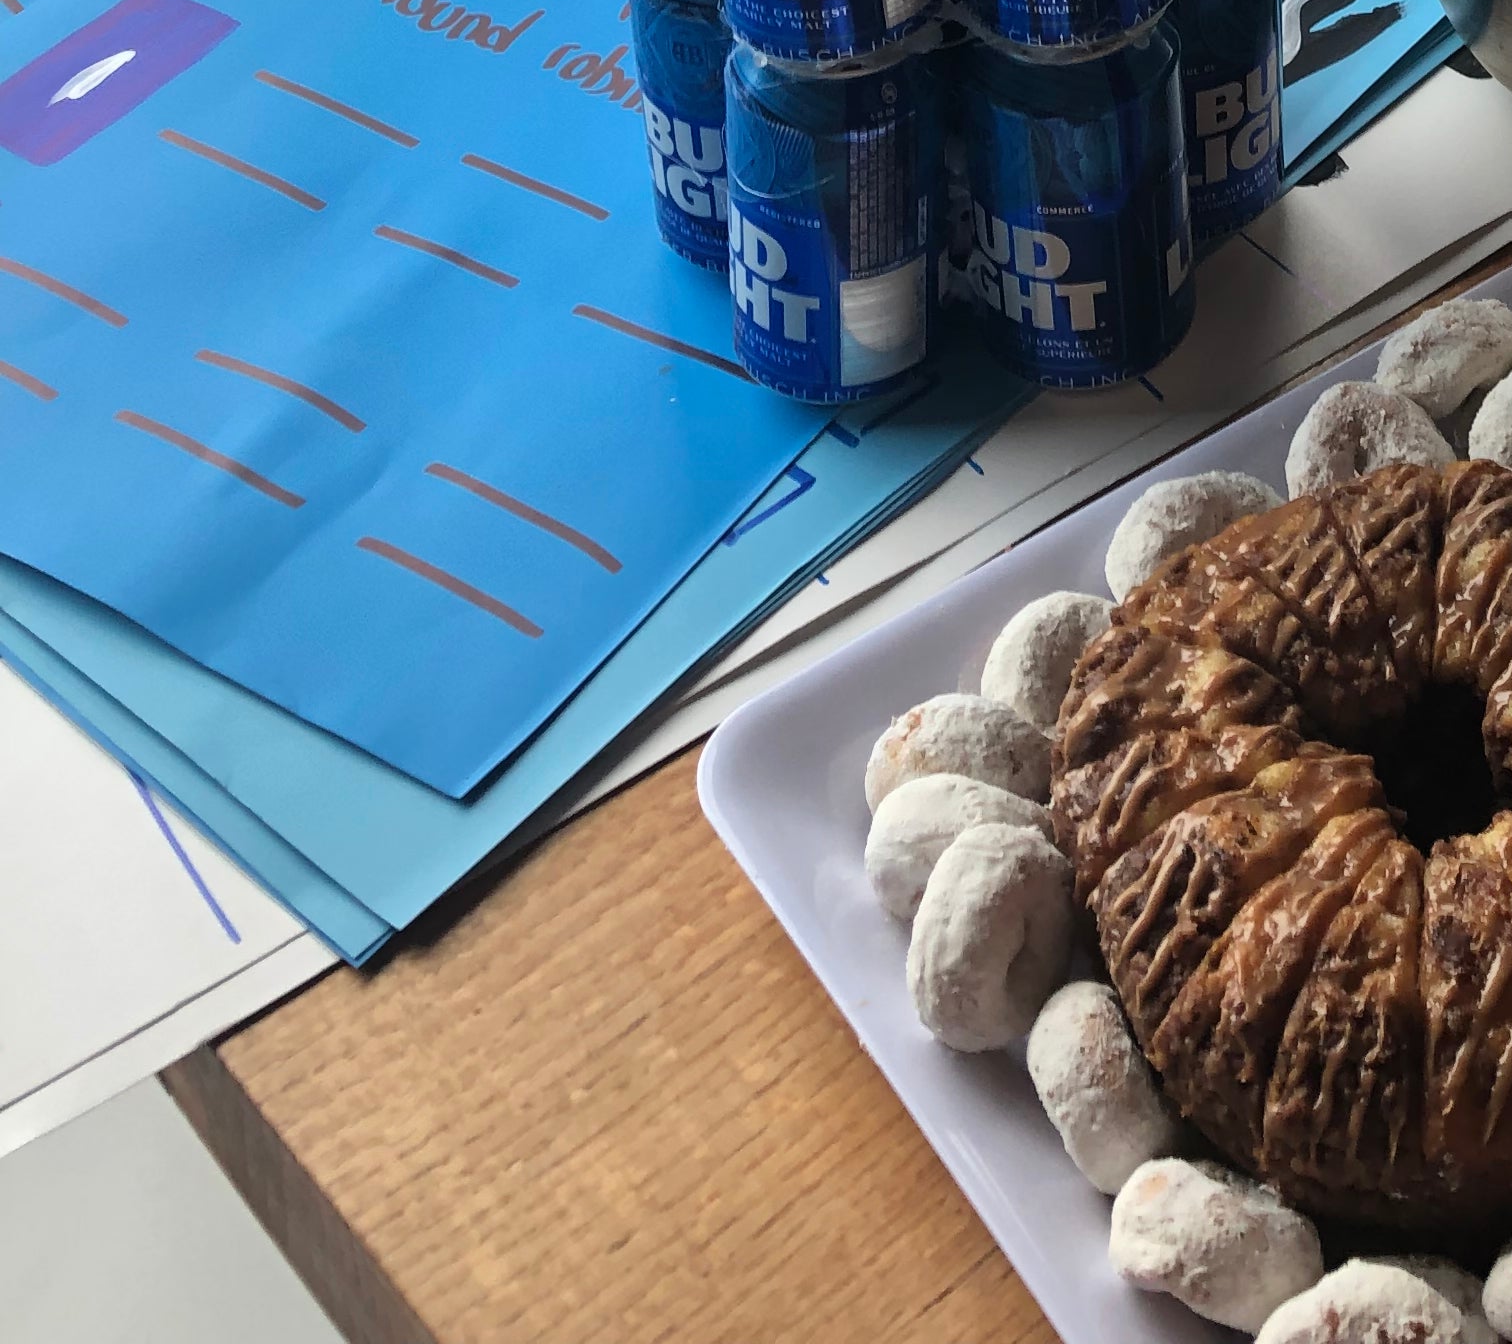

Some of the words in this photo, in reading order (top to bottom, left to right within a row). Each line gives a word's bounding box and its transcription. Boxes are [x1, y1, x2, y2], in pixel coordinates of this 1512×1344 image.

[773, 5, 848, 20] CHOICEST
[790, 18, 831, 31] MALT
[643, 92, 724, 173] BU
[1195, 48, 1278, 138] BU
[973, 199, 1071, 280] UD
[1036, 205, 1094, 216] COMMERCE
[967, 248, 1107, 332] GHT
